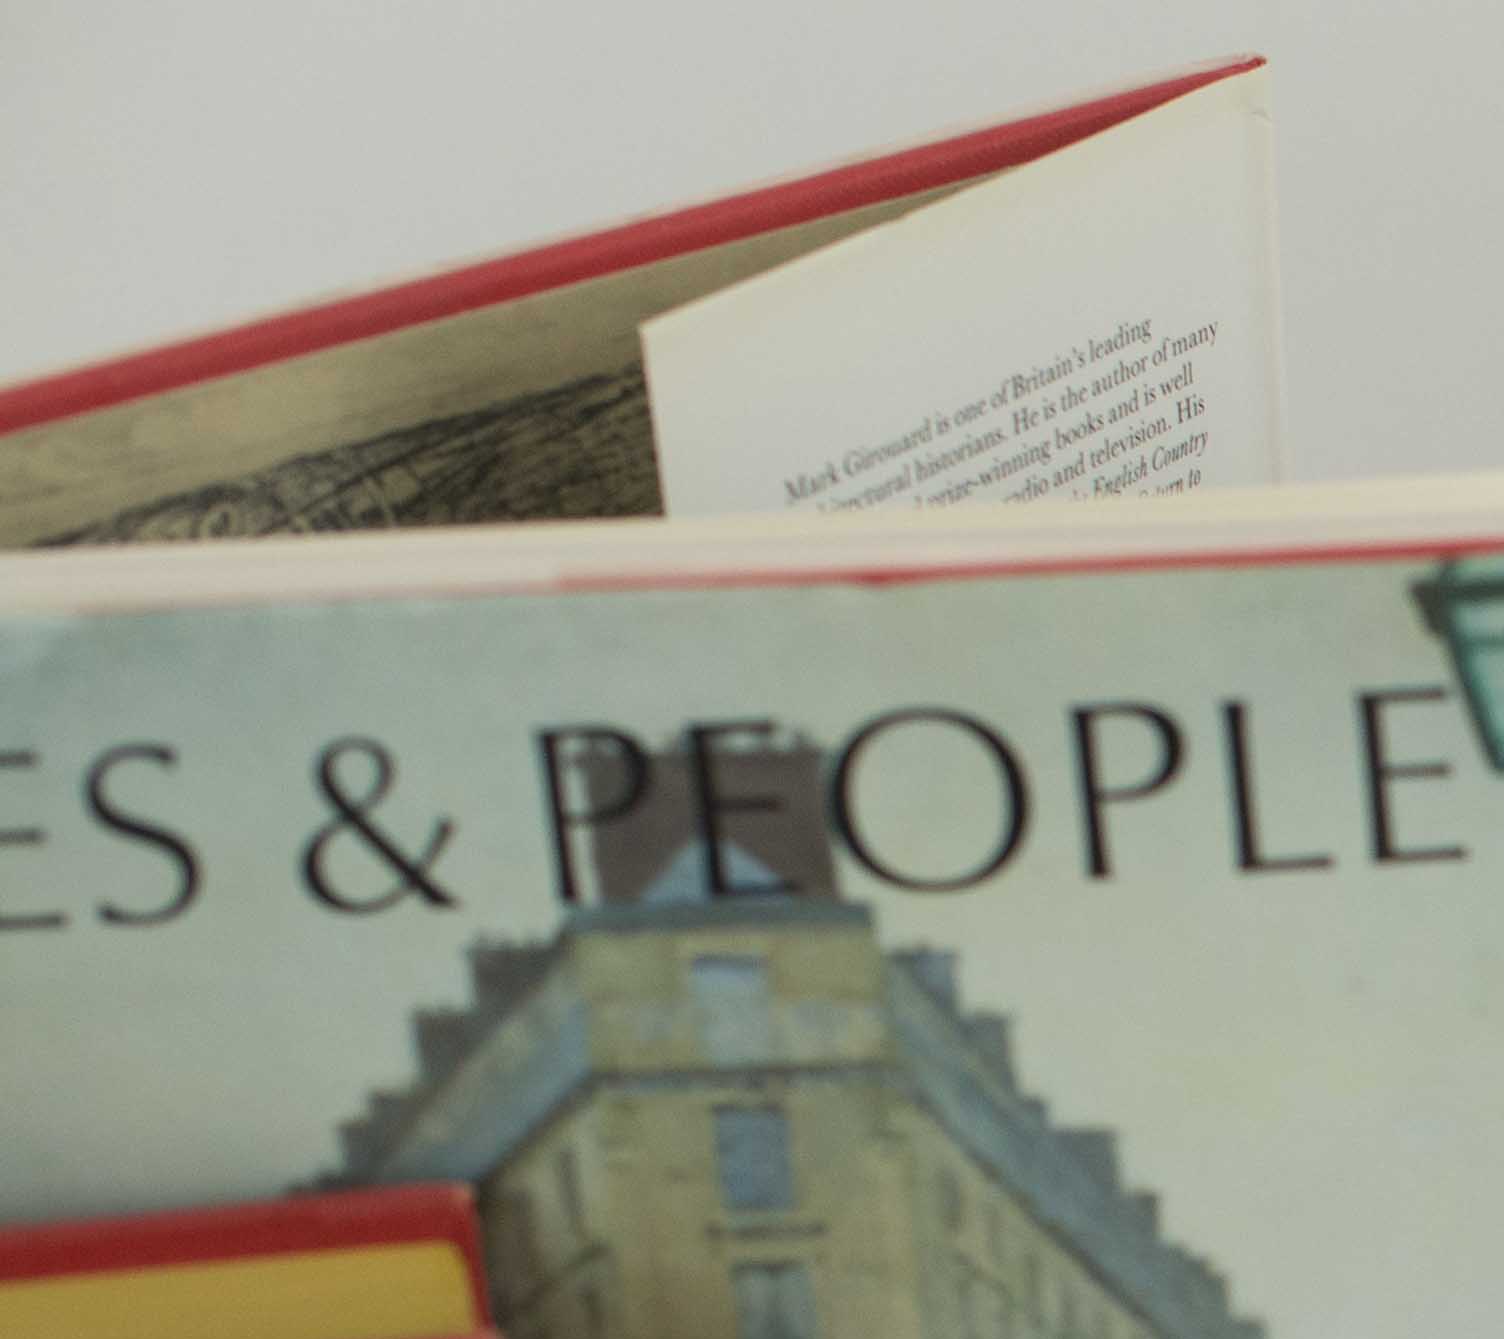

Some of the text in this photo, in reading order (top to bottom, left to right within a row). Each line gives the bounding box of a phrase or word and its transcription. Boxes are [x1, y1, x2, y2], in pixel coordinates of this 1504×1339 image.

[784, 460, 840, 500] Mark
[934, 407, 951, 436] is
[953, 398, 987, 427] one
[989, 379, 1012, 410] of
[1011, 346, 1086, 399] Britain's
[1088, 318, 1152, 362] leading
[1012, 405, 1040, 436] He
[1043, 399, 1056, 420] is
[1061, 386, 1088, 412] the
[1091, 356, 1149, 397] author
[1151, 337, 1170, 367] of
[1171, 321, 1219, 358] many
[1055, 411, 1105, 451] books
[1107, 390, 1140, 425] and
[1143, 383, 1157, 406] is
[1160, 361, 1194, 396] well
[1053, 451, 1087, 488] and
[1089, 416, 1173, 467] television.
[1175, 393, 1206, 425] His
[1091, 431, 1209, 498] English Country
[1187, 468, 1202, 488] to
[297, 735, 462, 917] &
[533, 686, 1474, 903] PEOPLE
